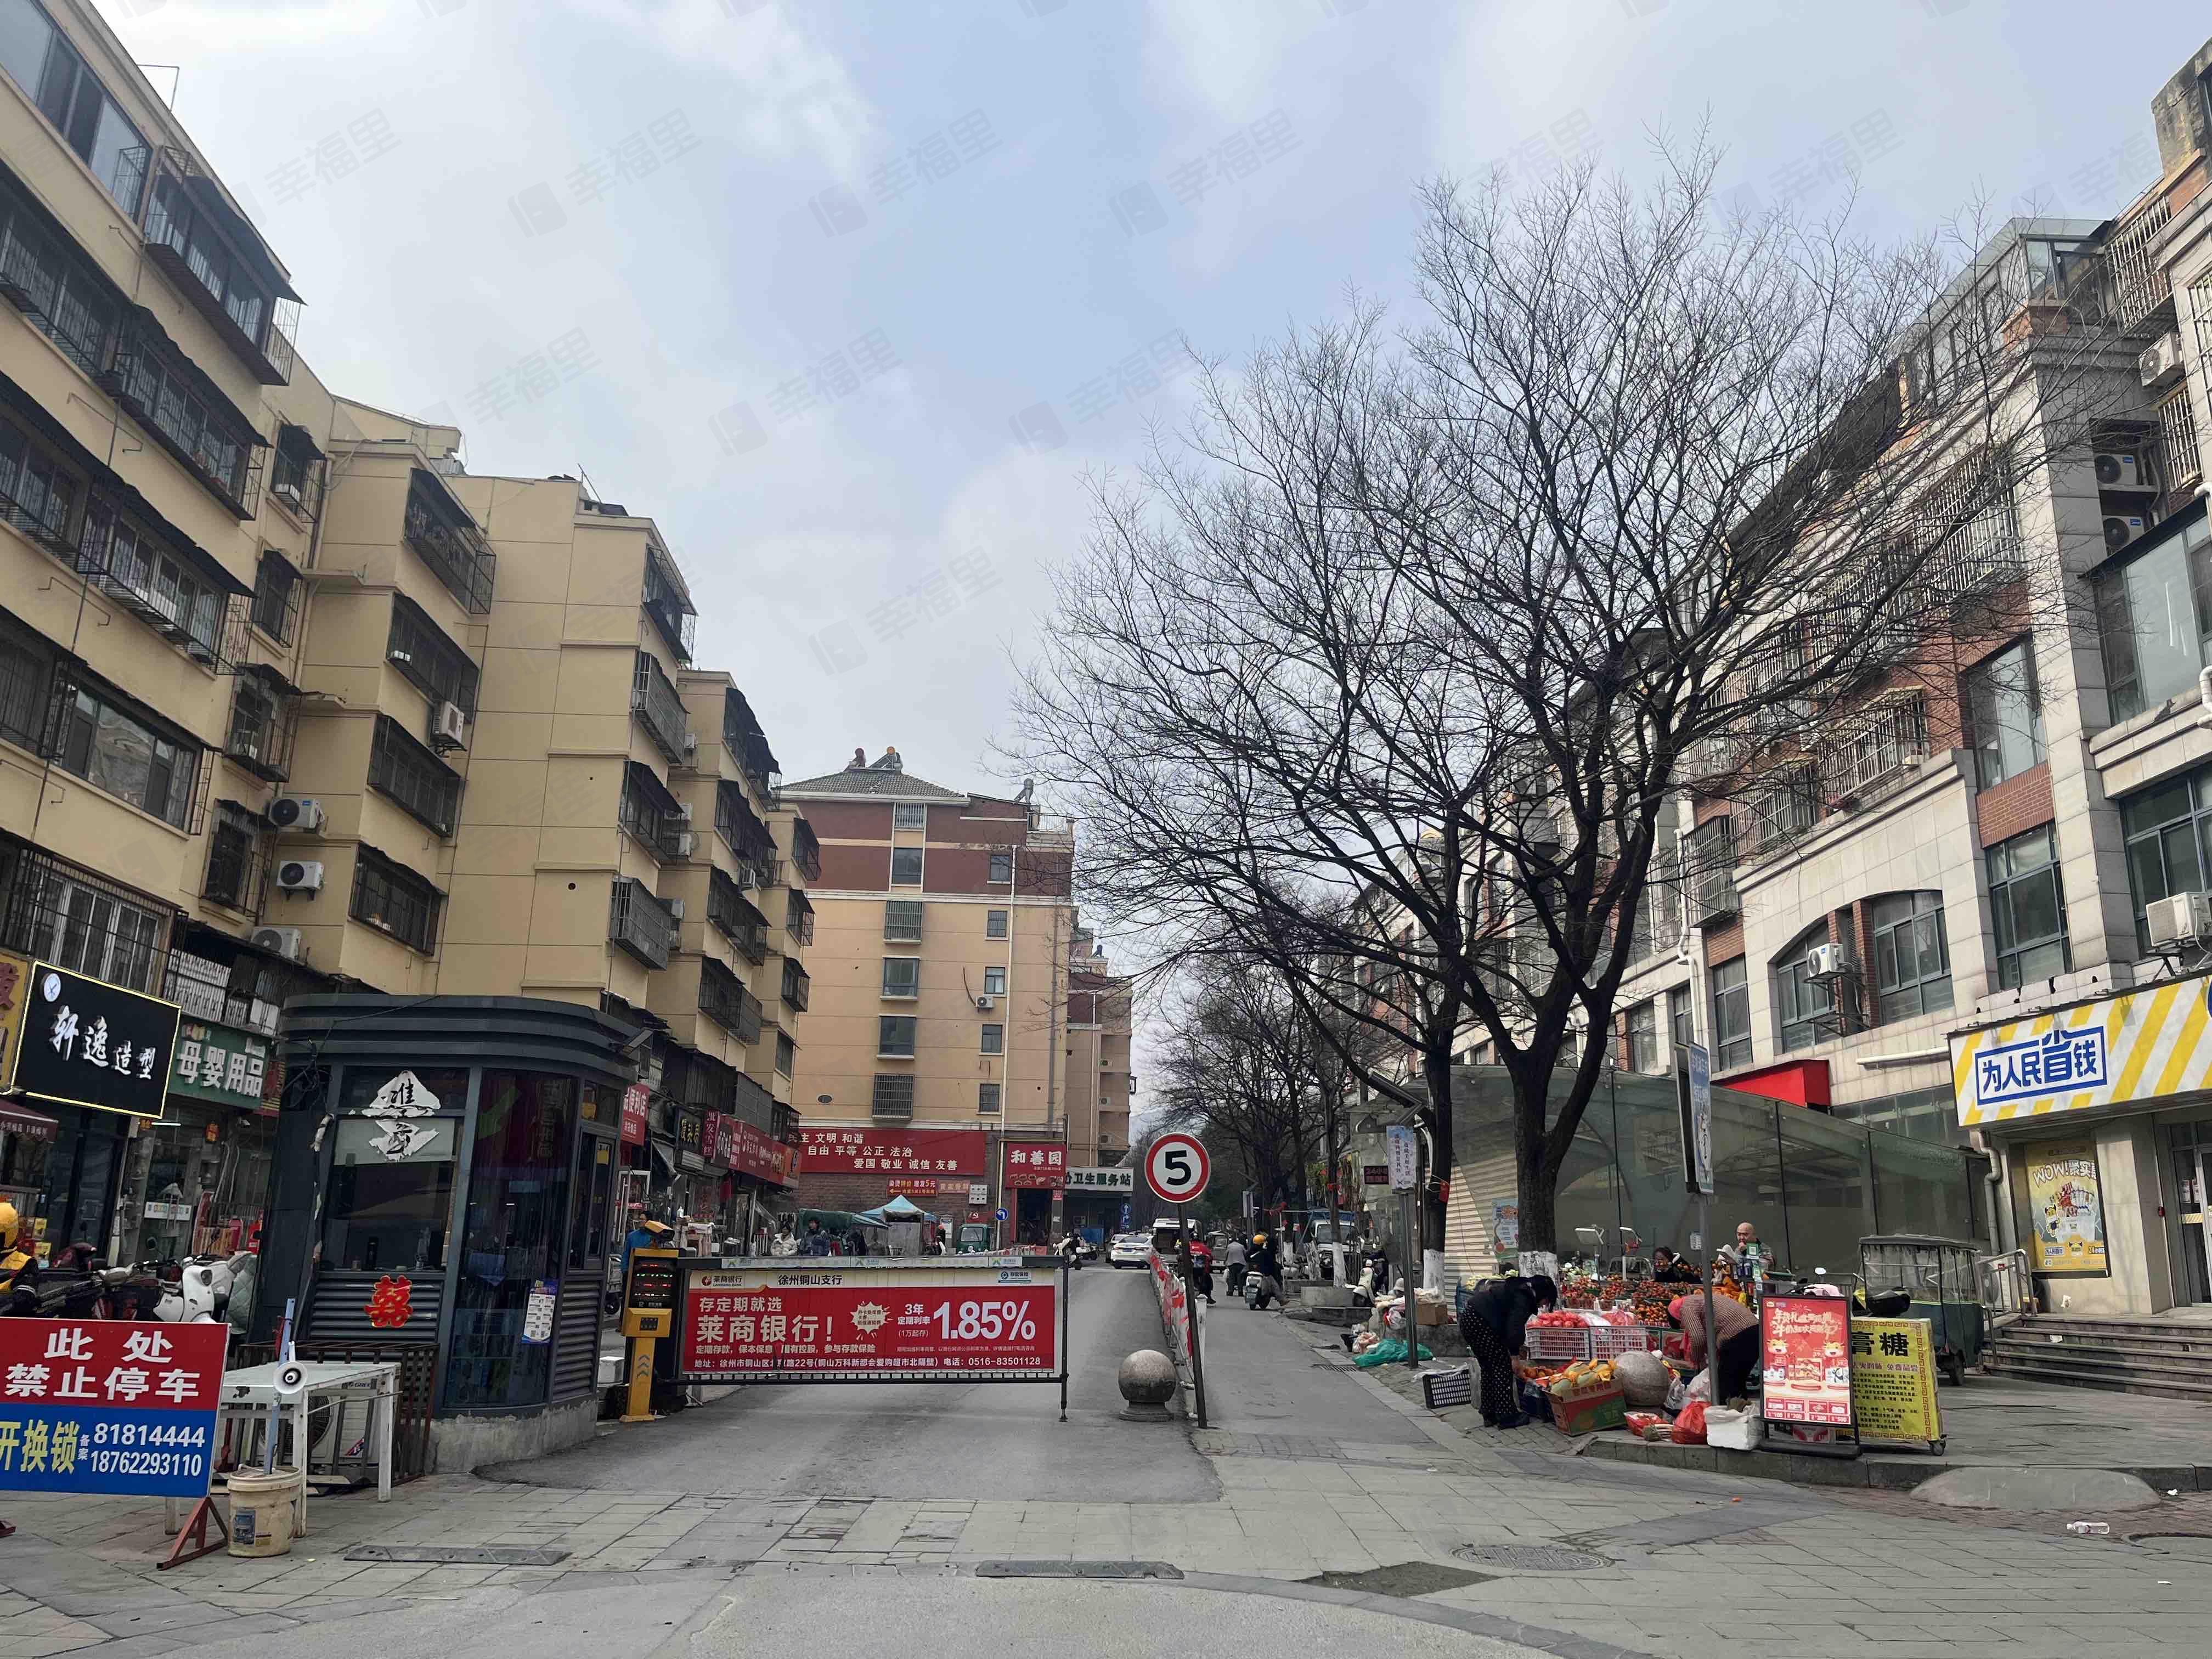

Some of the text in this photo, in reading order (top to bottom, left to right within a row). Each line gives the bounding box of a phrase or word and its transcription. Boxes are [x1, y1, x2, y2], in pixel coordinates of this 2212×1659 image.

[50, 1006, 157, 1080] 轩逸造型
[176, 1039, 266, 1097] 母婴用品
[1983, 1029, 2097, 1093] 为人民省钱
[816, 1133, 837, 1143] 文明
[842, 1133, 864, 1144] 和谐
[808, 1146, 913, 1157] 自由 平等 公正 法治
[1011, 1150, 1062, 1165] 和善园
[854, 1159, 957, 1170] 爱国 敬业 诚信 友善
[1164, 1150, 1192, 1186] 5
[778, 1274, 842, 1285] 徐州铜山支行
[699, 1296, 782, 1312] 存定期就选
[905, 1304, 924, 1315] 3年
[898, 1316, 930, 1325] 定期利率
[933, 1300, 1035, 1340] 1.85%
[43, 1327, 174, 1363] 此处
[4, 1363, 200, 1403] 禁止停车
[78, 1434, 89, 1461] 备案
[93, 1423, 205, 1448] 81814444
[91, 1450, 202, 1476] 18762293110
